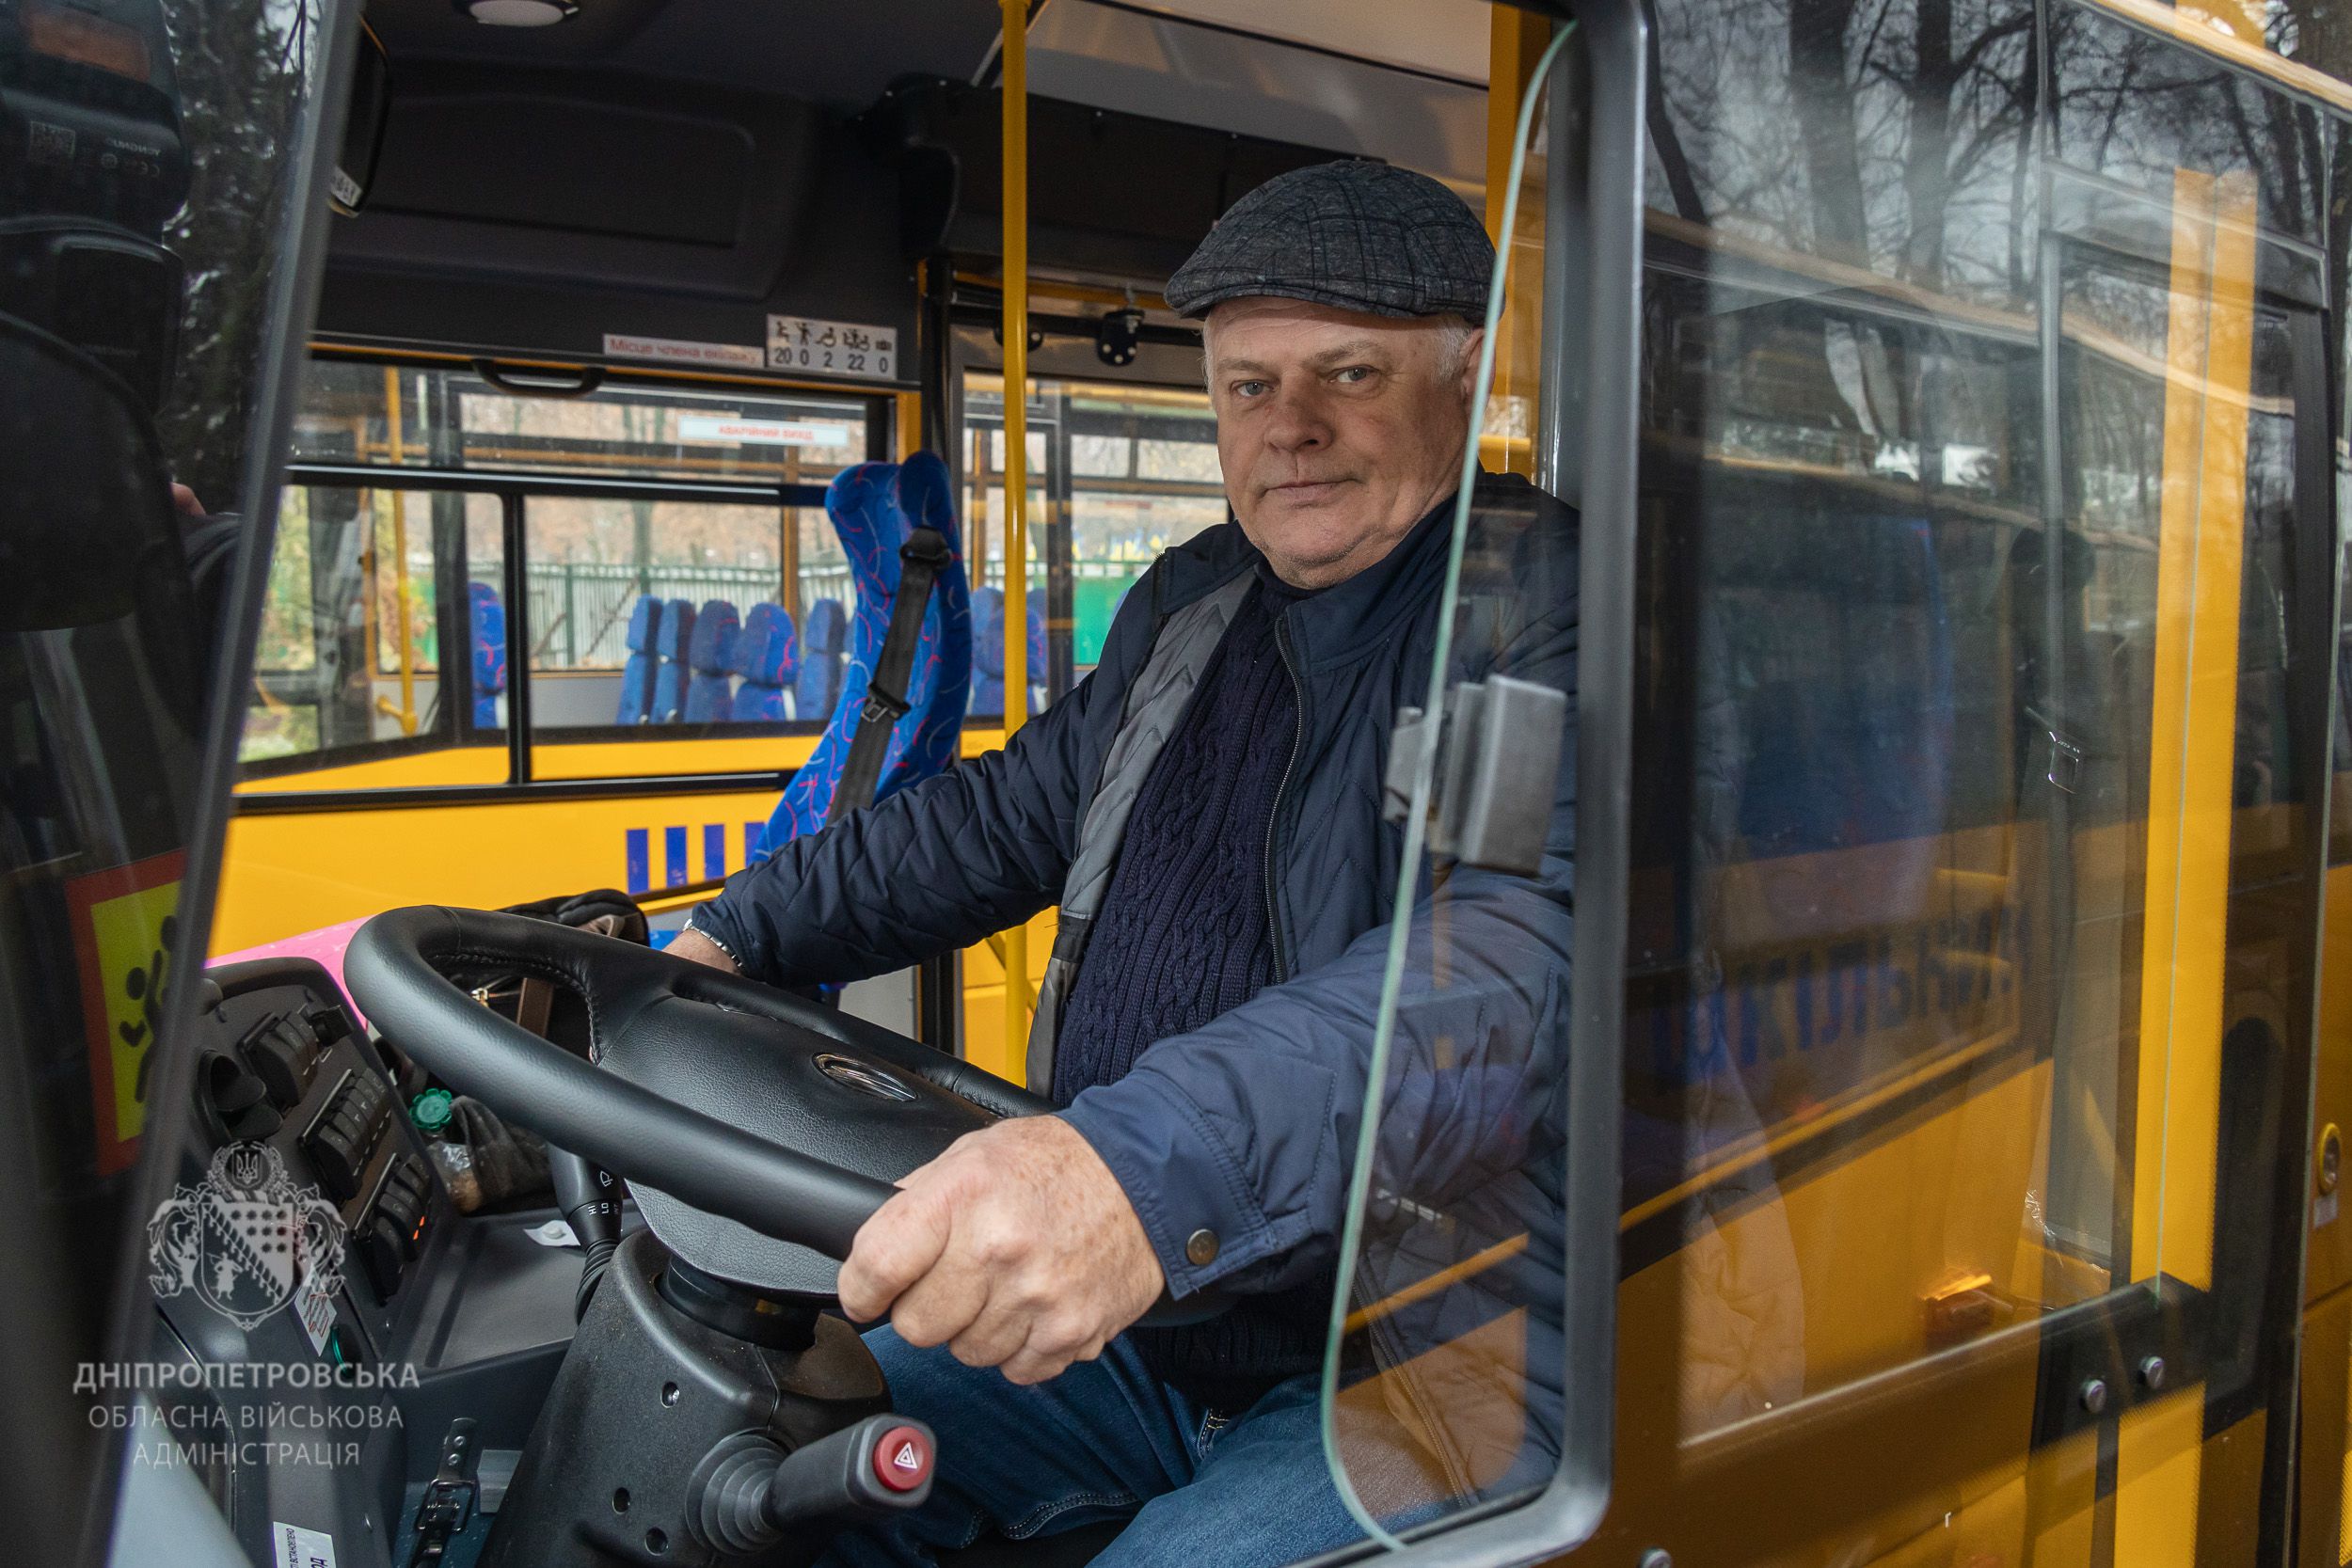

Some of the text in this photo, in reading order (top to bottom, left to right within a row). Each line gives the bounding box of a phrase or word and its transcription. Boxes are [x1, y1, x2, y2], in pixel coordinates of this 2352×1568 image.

[774, 346, 889, 373] 20 0 2 22 0
[587, 1204, 597, 1216] HI
[600, 1202, 610, 1214] LO
